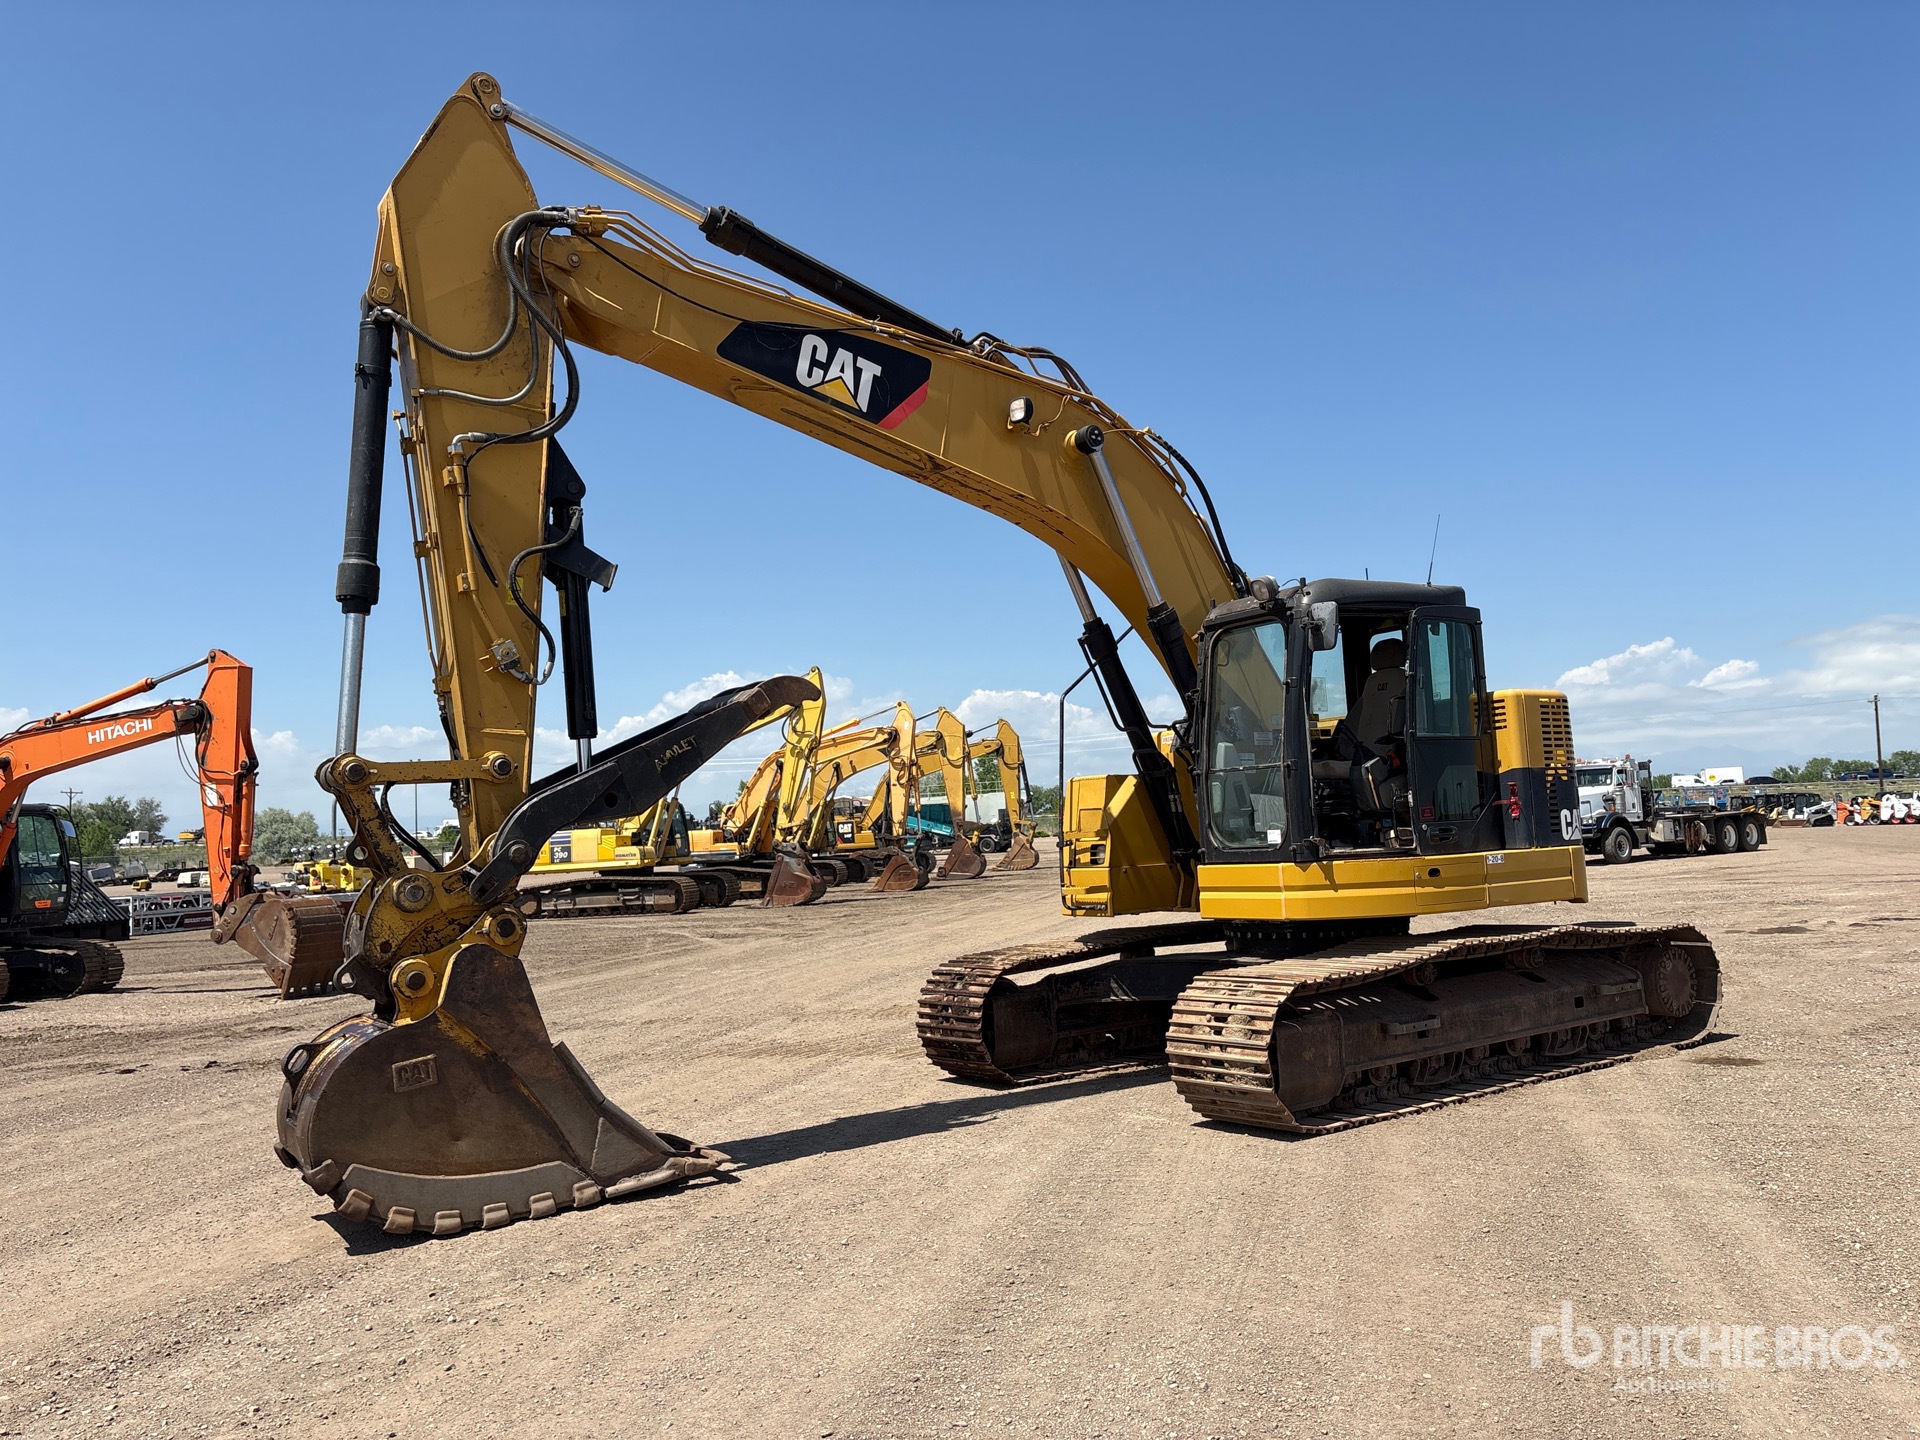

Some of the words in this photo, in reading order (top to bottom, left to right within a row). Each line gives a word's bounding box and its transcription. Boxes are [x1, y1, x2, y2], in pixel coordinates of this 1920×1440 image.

[796, 334, 882, 413] CAT
[87, 717, 153, 745] HITACHI
[838, 823, 852, 833] CAT
[1560, 808, 1580, 840] CA
[553, 851, 568, 859] 390
[398, 1060, 434, 1088] CAT
